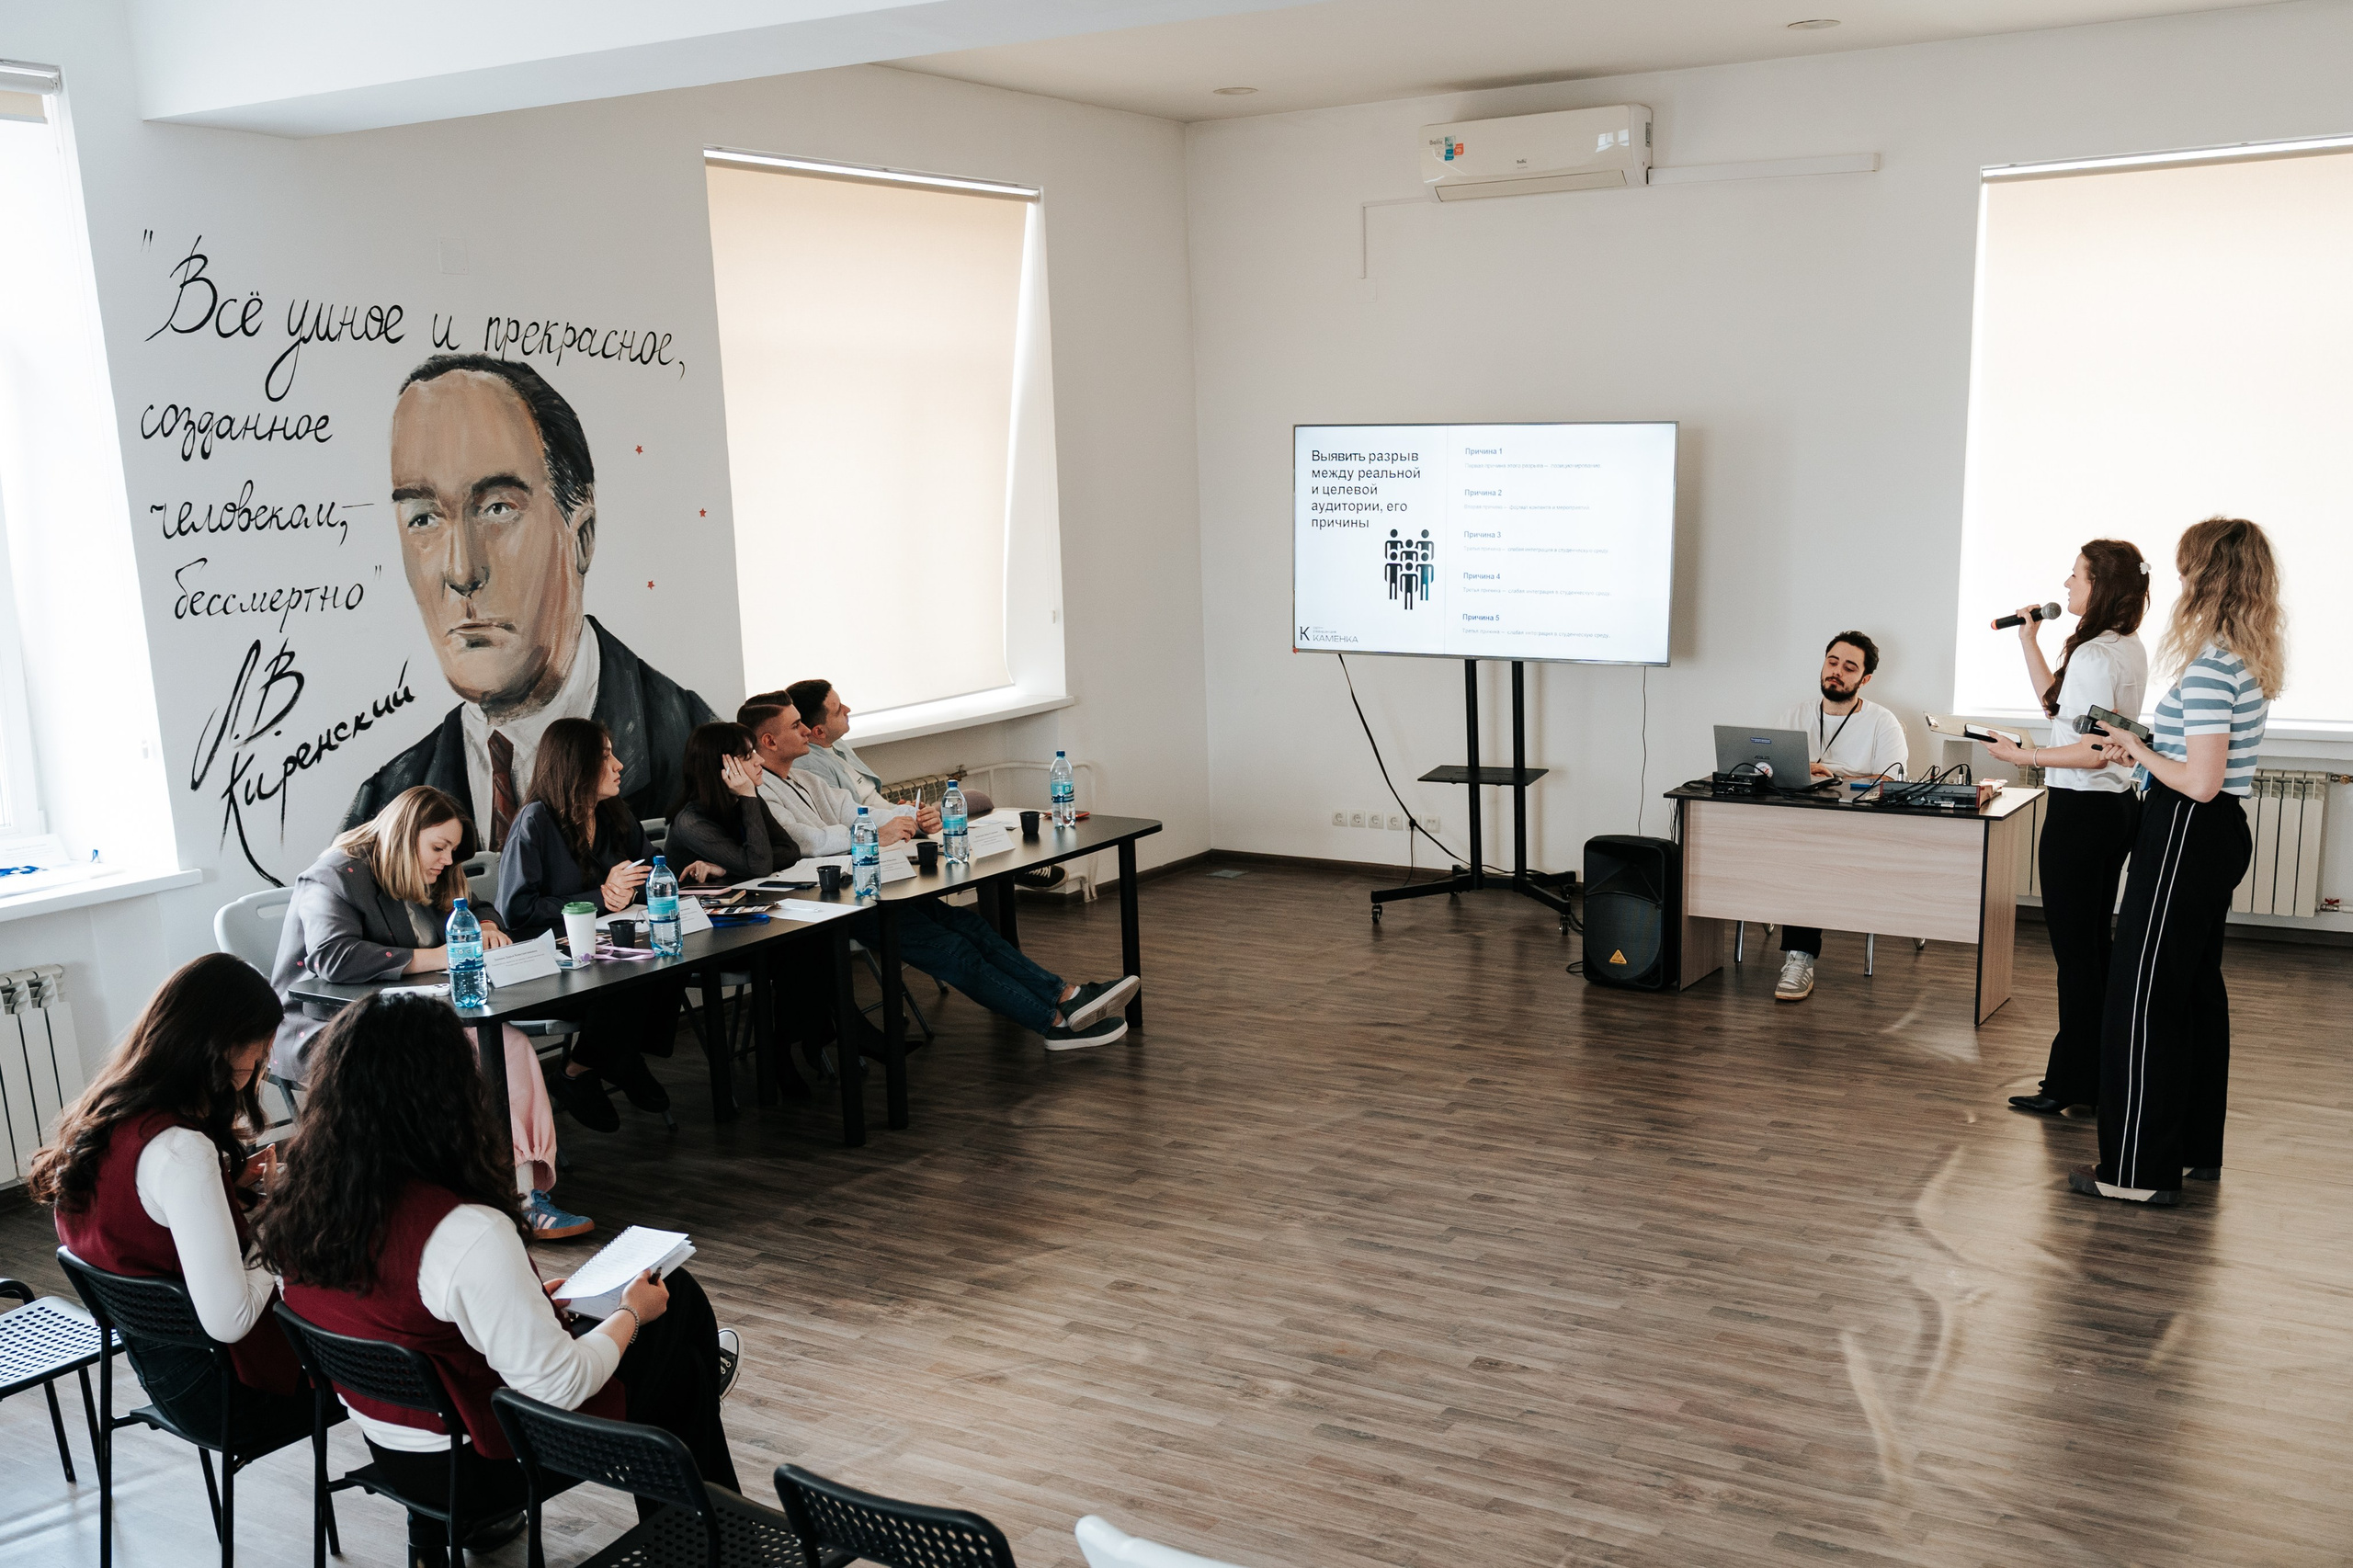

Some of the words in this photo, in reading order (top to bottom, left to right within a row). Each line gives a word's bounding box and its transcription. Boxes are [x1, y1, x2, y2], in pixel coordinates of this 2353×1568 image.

[265, 299, 406, 403] умное
[432, 312, 460, 351] и
[483, 315, 686, 381] прекрасное,
[141, 403, 334, 462] созданное
[1312, 449, 1366, 461] Выявить
[1369, 452, 1419, 464] разрыв
[1465, 448, 1497, 456] Причина
[1312, 469, 1354, 482] между
[1358, 466, 1421, 481] реальной
[1312, 486, 1319, 494] и
[1322, 483, 1378, 496] целевой
[1464, 489, 1496, 497] Причина
[1311, 502, 1383, 514] аудитории,
[1386, 503, 1407, 512] его
[1311, 518, 1370, 530] причины
[1463, 531, 1495, 540] Причина
[1463, 573, 1495, 581] Причина
[1462, 614, 1494, 622] Причина
[1313, 634, 1358, 643] КАМЕНКА
[219, 655, 417, 889] Киренский
